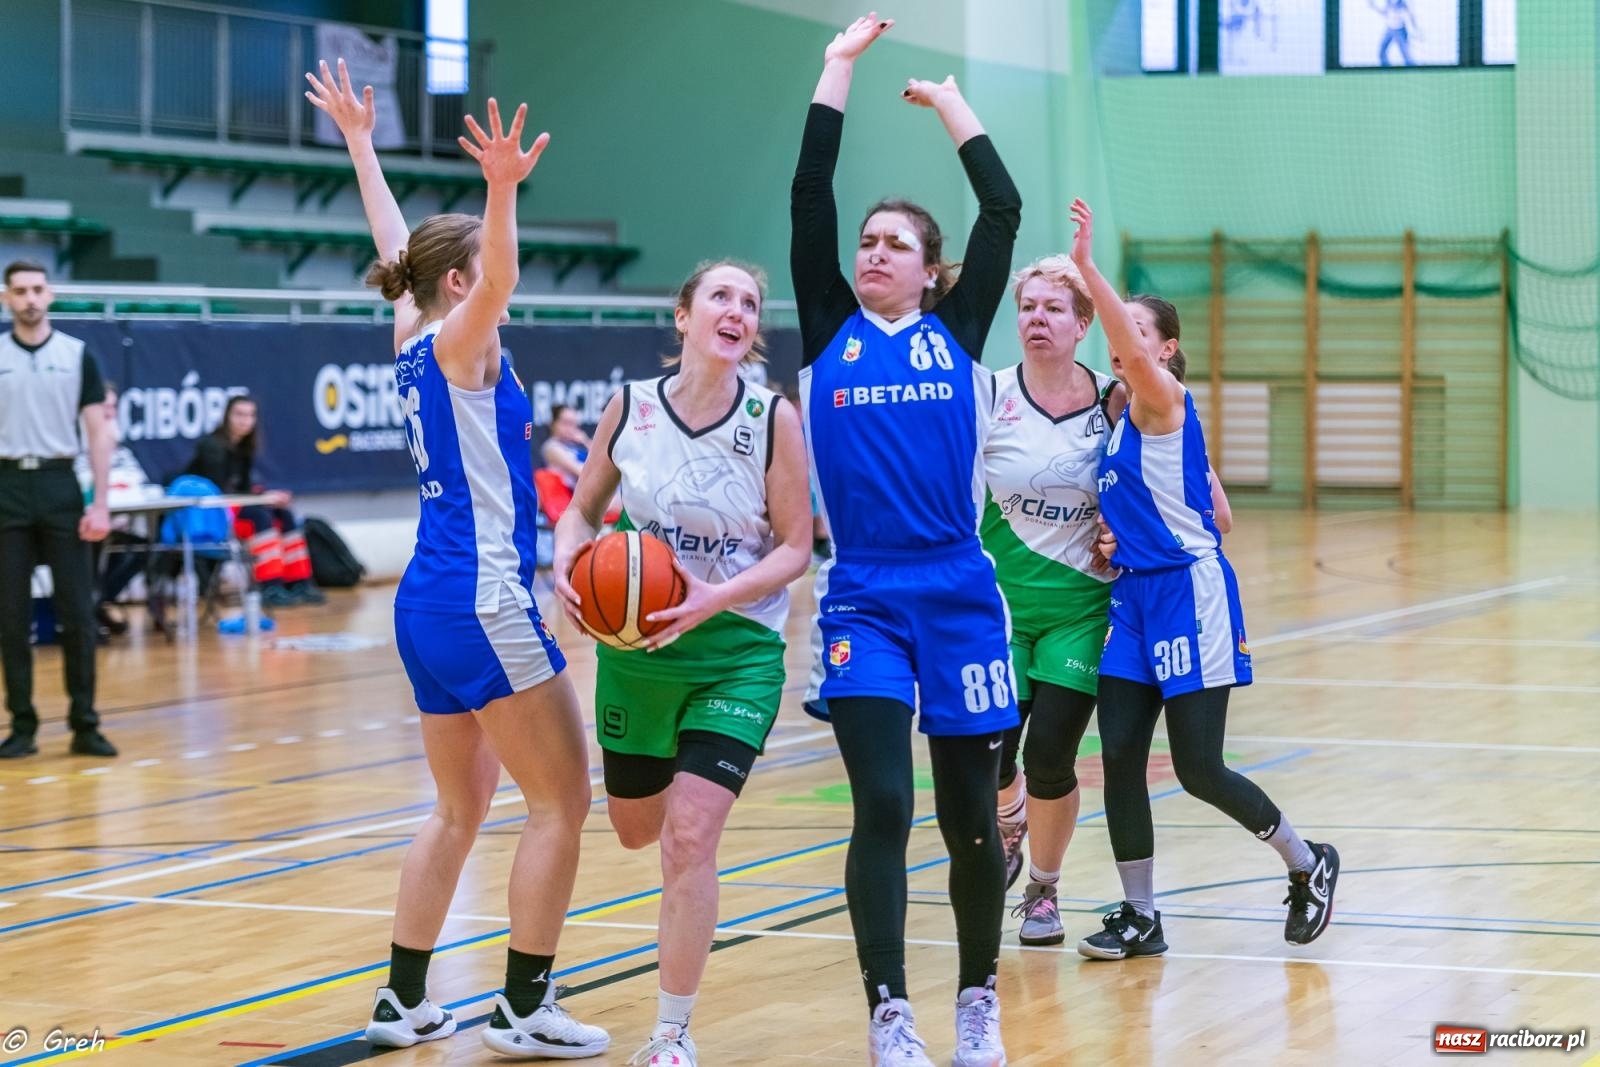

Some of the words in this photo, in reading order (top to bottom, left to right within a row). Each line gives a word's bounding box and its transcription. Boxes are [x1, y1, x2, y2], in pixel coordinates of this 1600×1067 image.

[853, 382, 954, 405] BETARD
[733, 424, 755, 456] 9
[1021, 498, 1097, 522] Clavis
[1153, 636, 1192, 682] 30
[960, 659, 1010, 714] 88
[603, 704, 628, 739] 9
